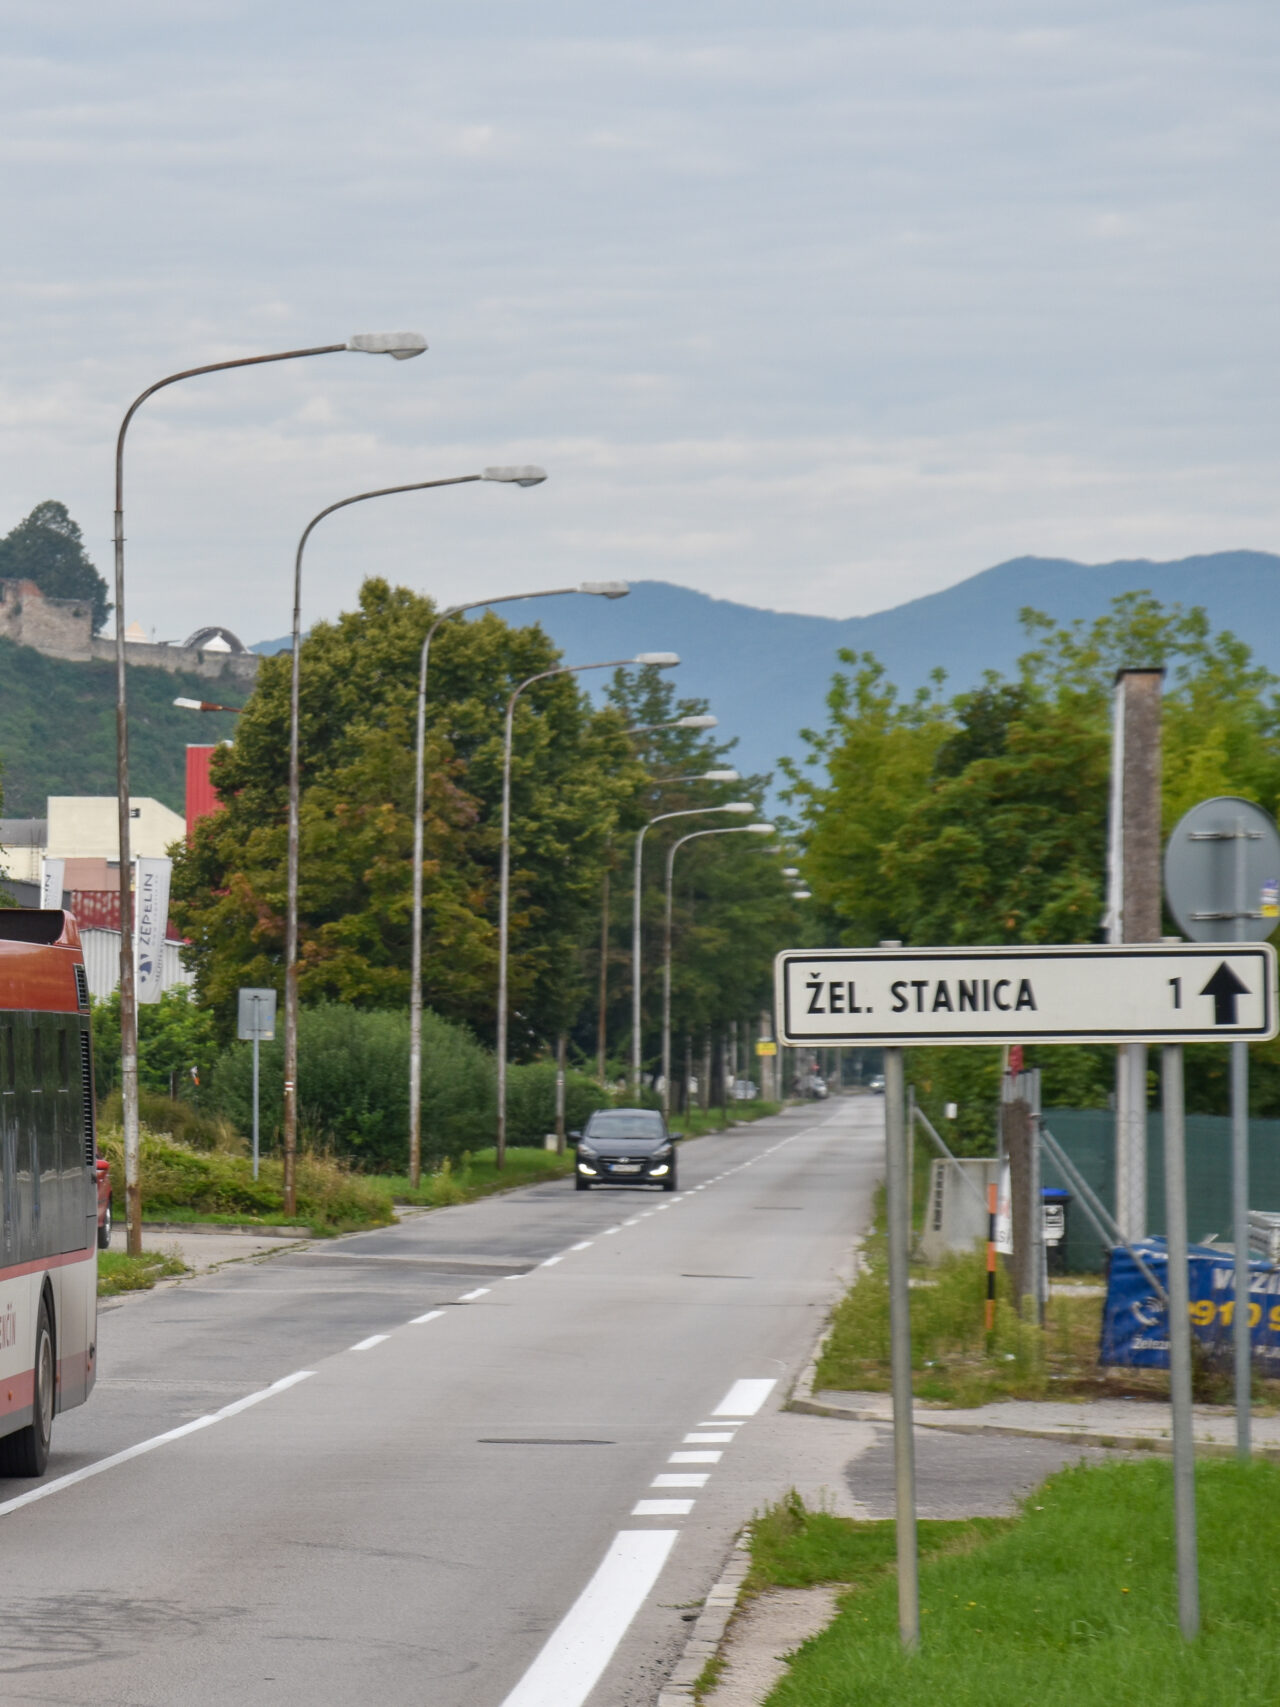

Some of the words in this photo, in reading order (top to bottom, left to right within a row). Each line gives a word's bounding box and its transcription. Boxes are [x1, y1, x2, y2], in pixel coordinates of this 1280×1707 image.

[139, 873, 155, 946] ZEPELIN
[805, 972, 874, 1014] ŽEL.
[890, 978, 1039, 1013] STANICA
[1168, 976, 1183, 1010] 1
